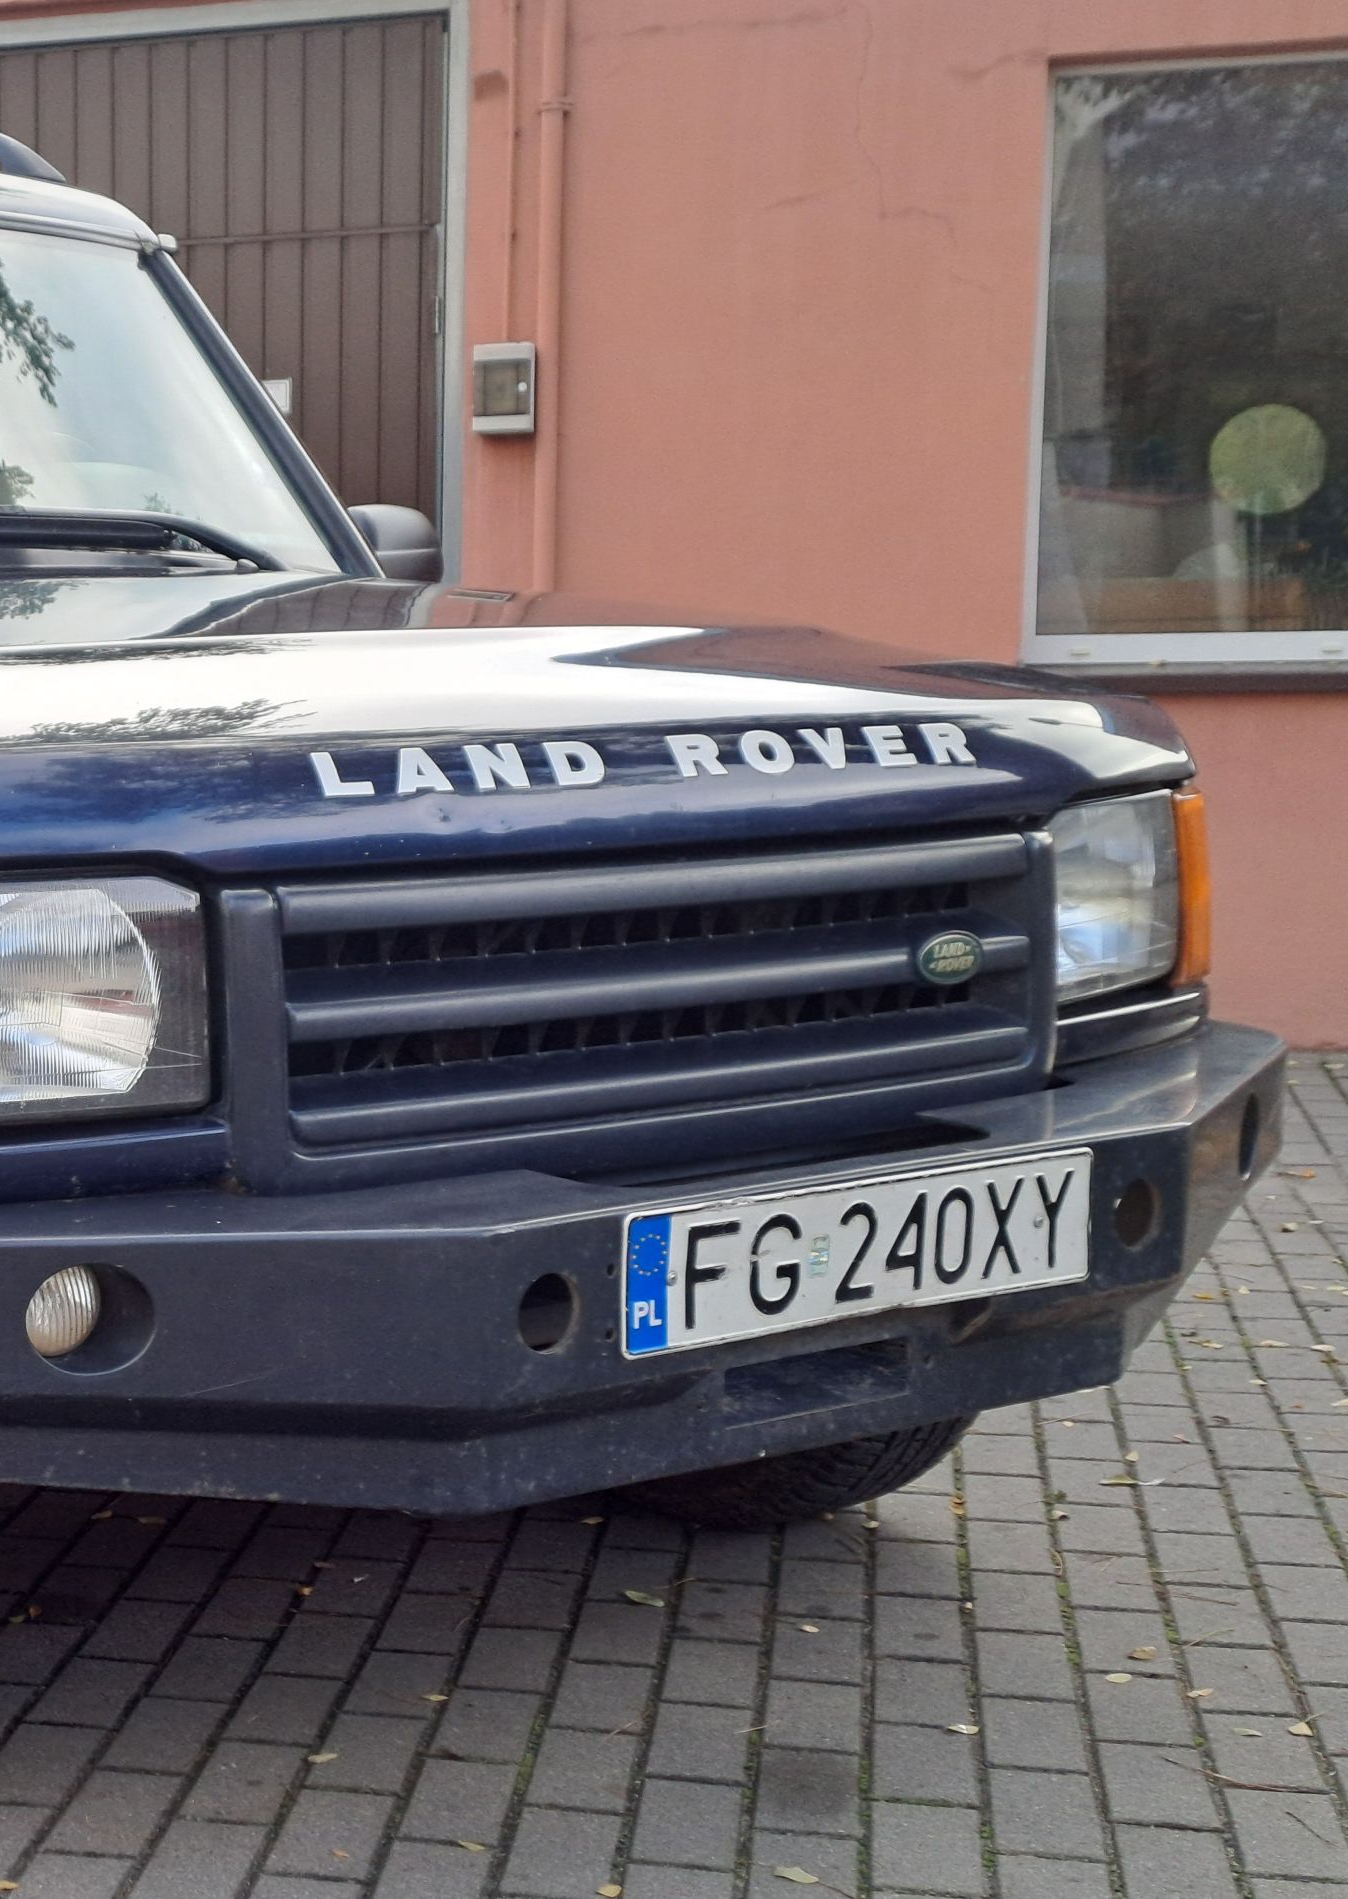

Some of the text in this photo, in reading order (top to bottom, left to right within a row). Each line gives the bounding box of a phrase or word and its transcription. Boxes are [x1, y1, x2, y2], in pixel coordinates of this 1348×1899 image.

[309, 721, 978, 797] LAND ROVER
[933, 941, 965, 959] LAND
[684, 1168, 1075, 1330] FG 240XY
[633, 1301, 662, 1331] PL
